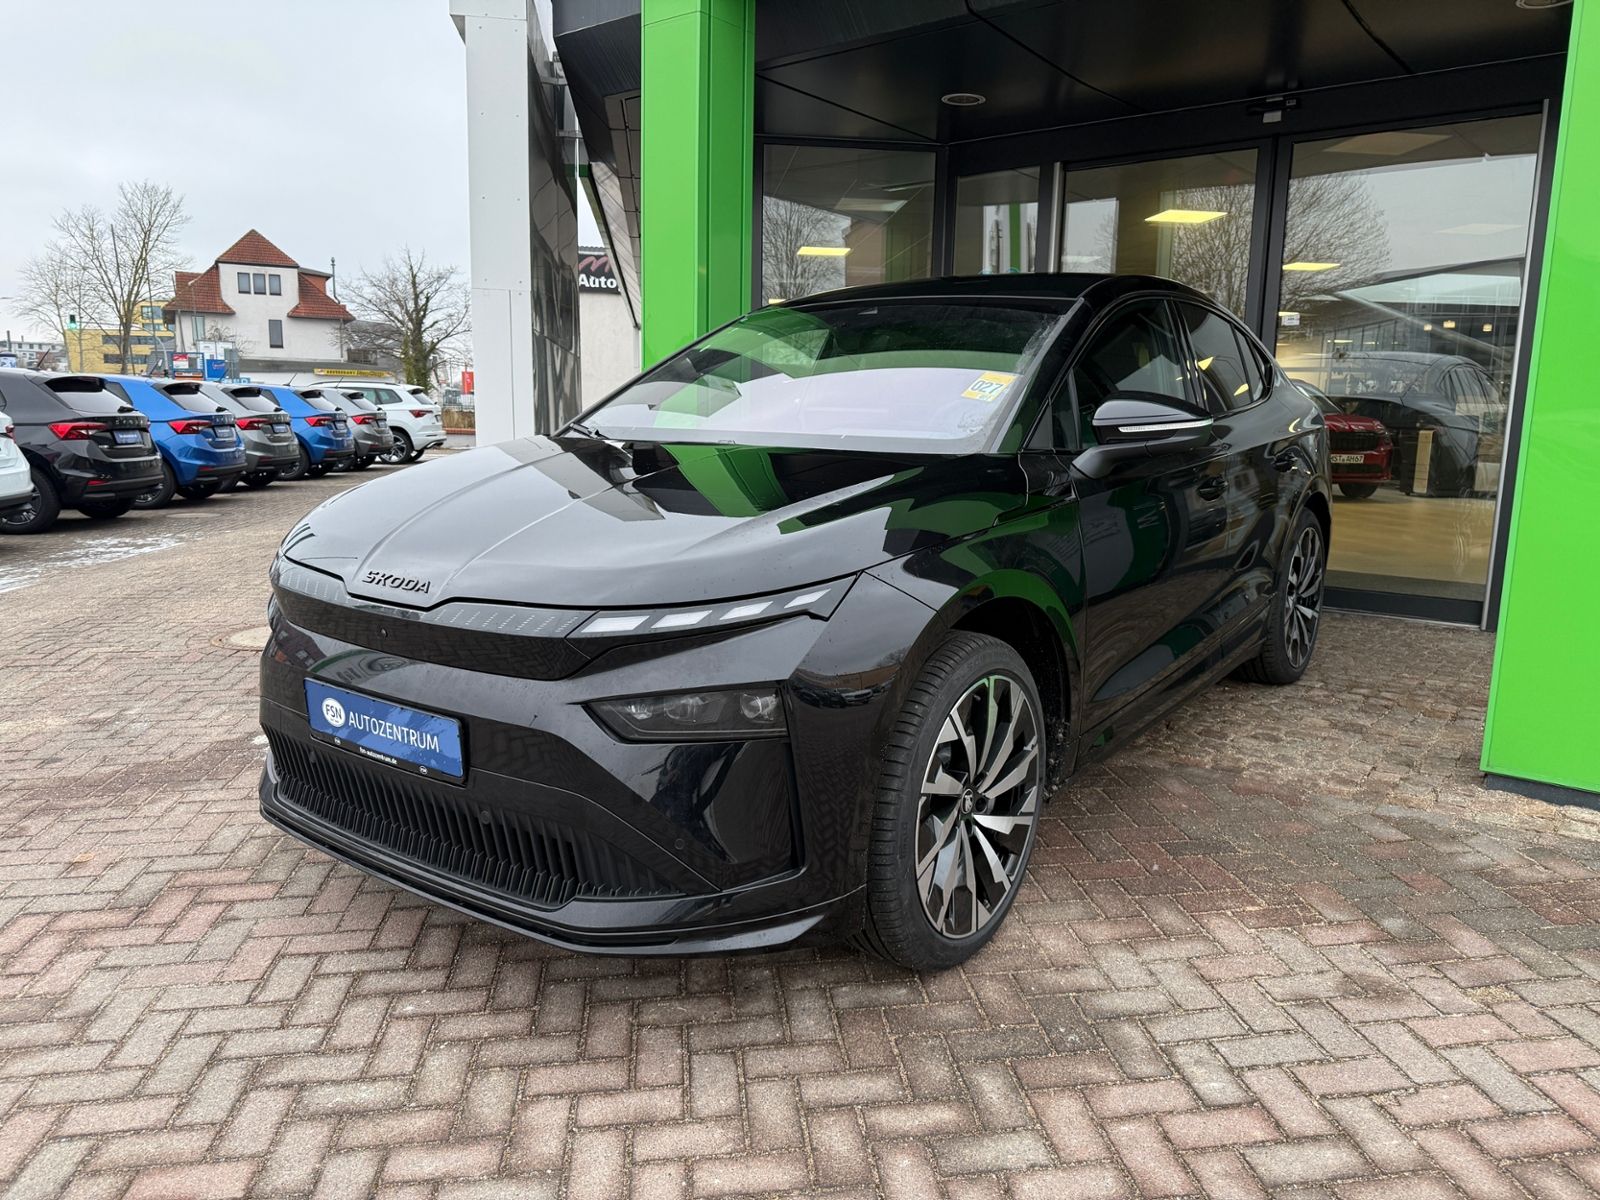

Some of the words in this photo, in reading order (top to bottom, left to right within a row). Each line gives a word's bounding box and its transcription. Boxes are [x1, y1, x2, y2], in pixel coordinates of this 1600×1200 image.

[579, 273, 617, 288] Auto
[970, 380, 1003, 393] 027
[325, 704, 342, 720] FSN
[348, 711, 440, 753] AUTOZENTRUM
